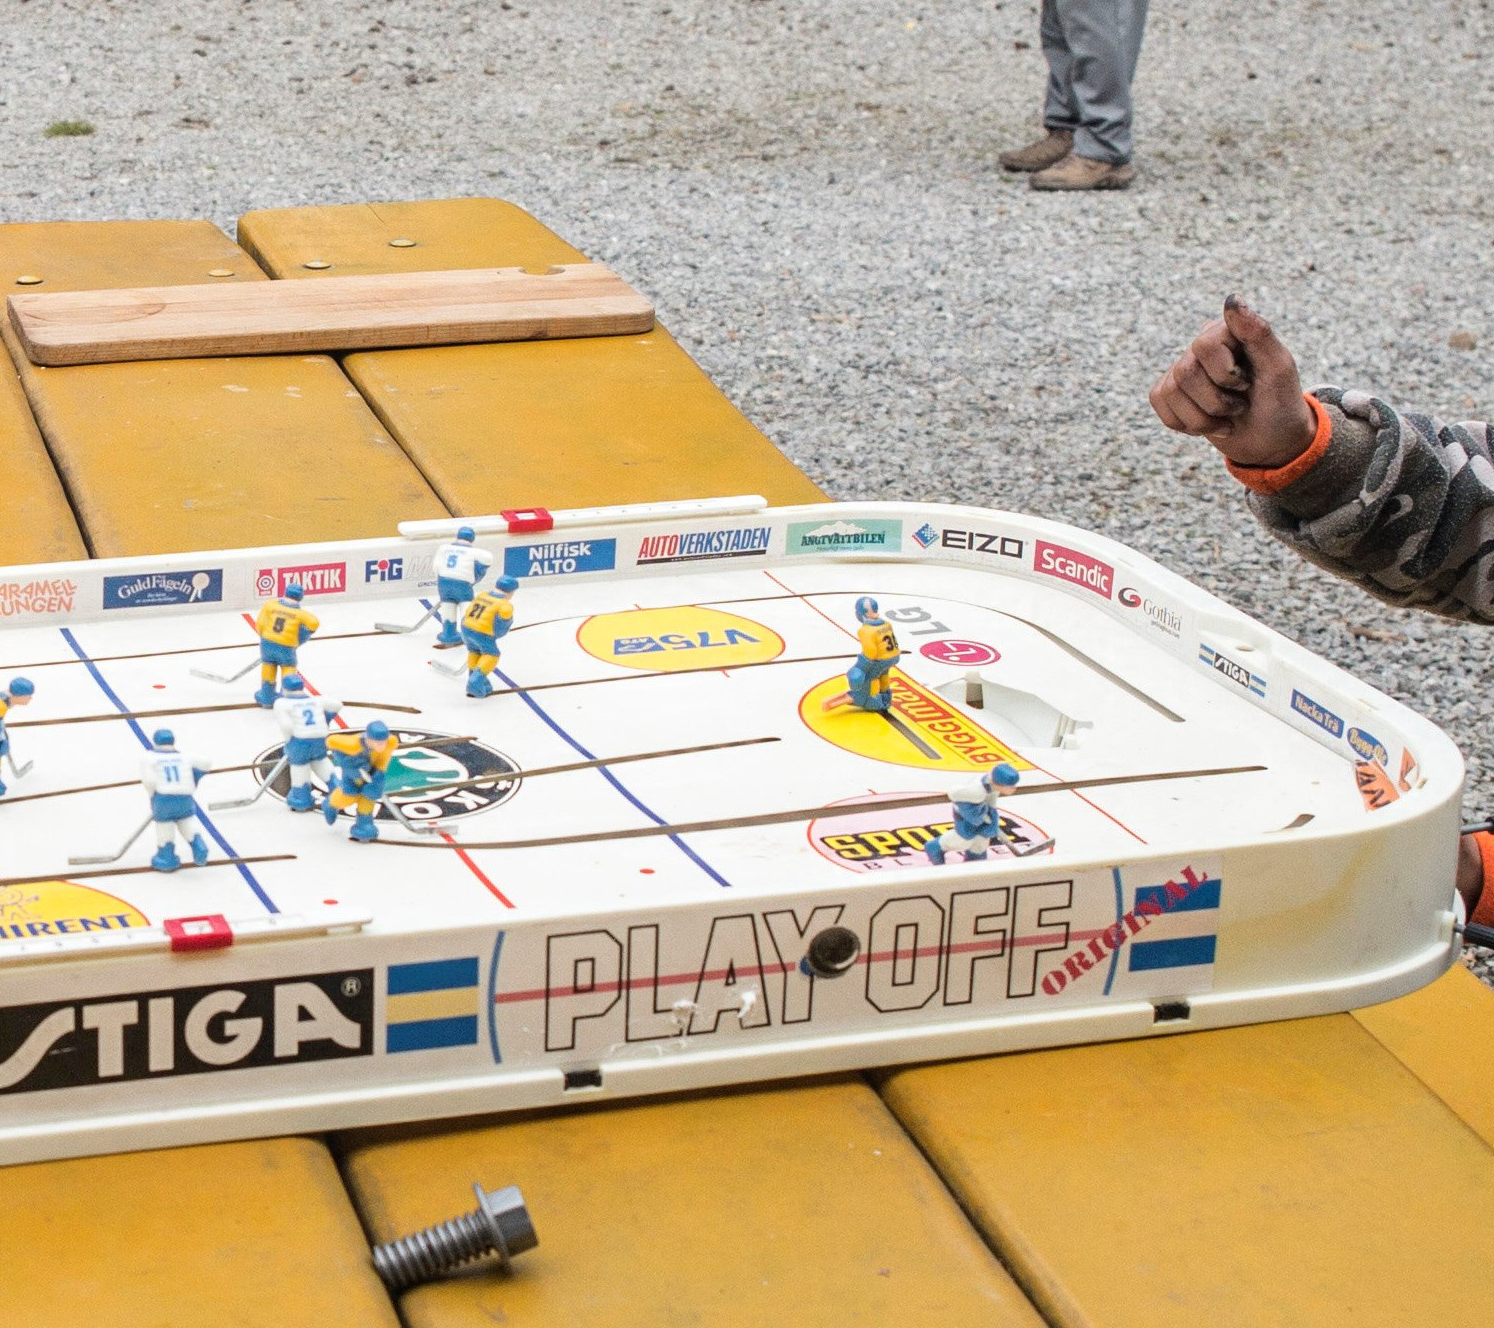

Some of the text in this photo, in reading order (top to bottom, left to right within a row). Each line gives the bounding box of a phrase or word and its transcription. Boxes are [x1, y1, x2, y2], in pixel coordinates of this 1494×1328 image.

[529, 542, 592, 560] Nilfisk
[638, 527, 771, 558] AUTOVERKSTADEN
[942, 529, 1023, 558] EIZO
[282, 568, 342, 591] TAKTIK
[529, 559, 577, 576] ALTO
[1042, 548, 1108, 593] Scandic
[885, 606, 952, 635] LG
[1143, 598, 1181, 631] Gothia
[659, 628, 761, 650] V75
[1215, 655, 1249, 687] STIGA
[302, 709, 316, 726] 2
[163, 764, 180, 783] 11
[1040, 864, 1211, 997] ORIGINAL
[545, 880, 1074, 1052] PLAY OFF
